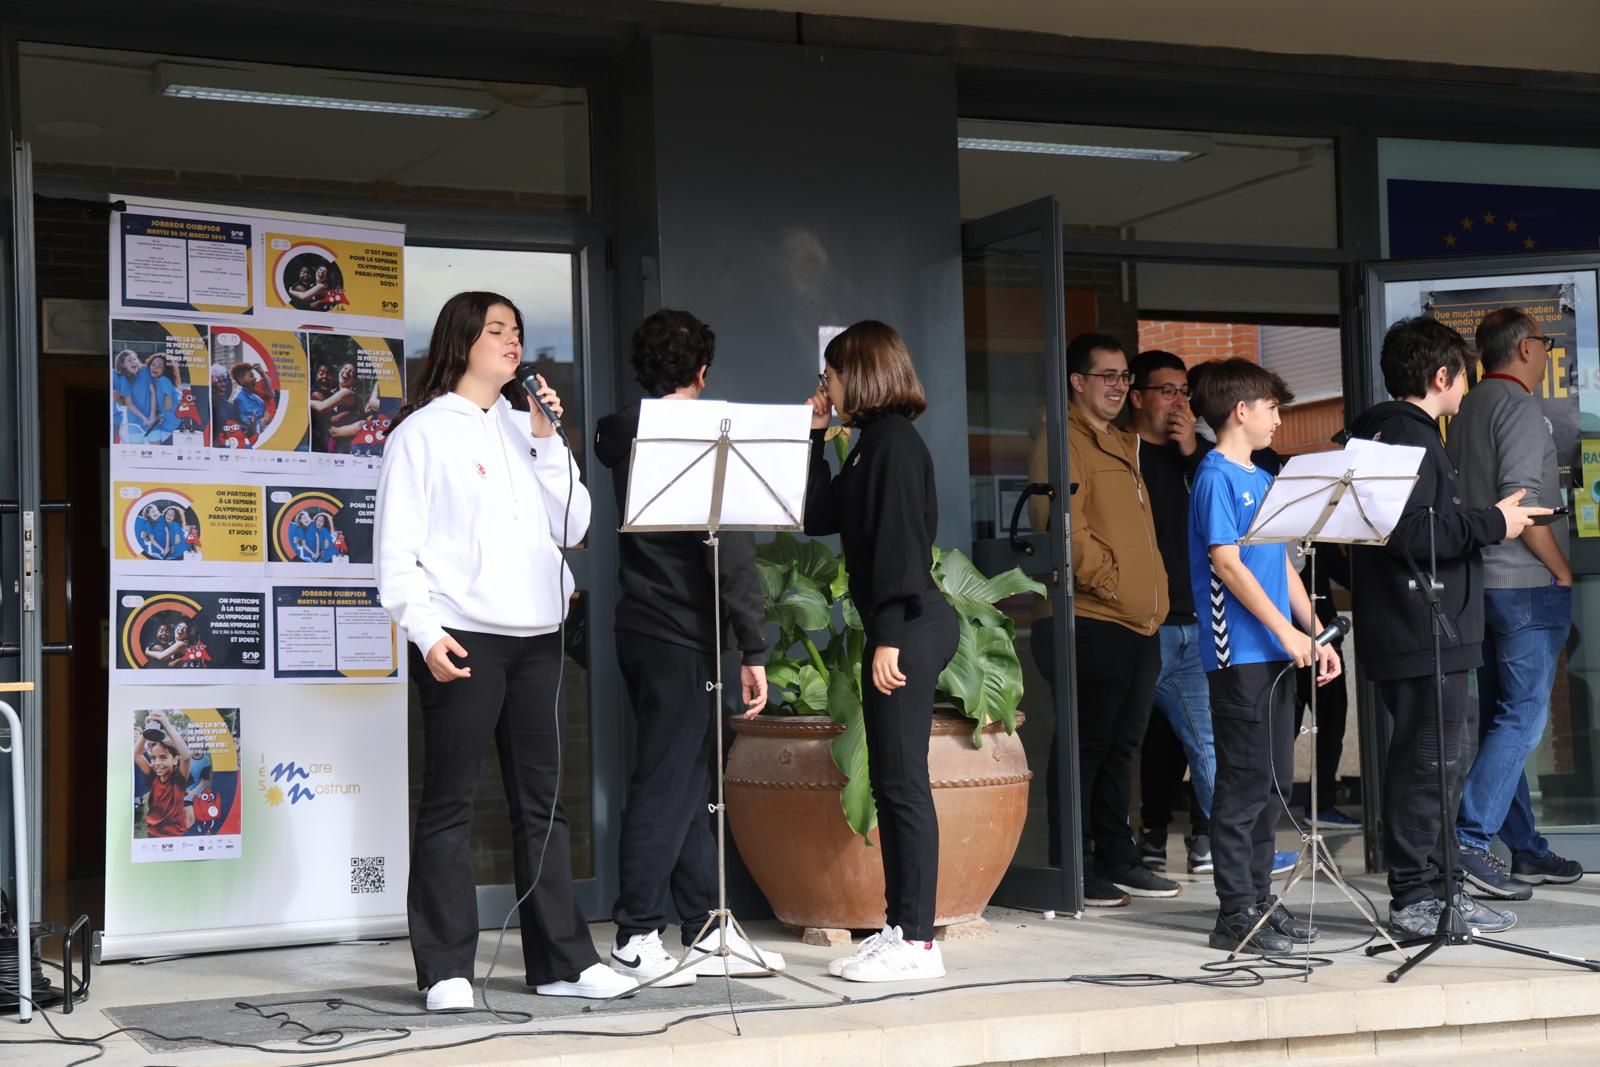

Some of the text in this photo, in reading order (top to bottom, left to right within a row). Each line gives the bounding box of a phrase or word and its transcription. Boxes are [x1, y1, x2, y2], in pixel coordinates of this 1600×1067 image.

[152, 220, 185, 229] JORNADA
[357, 263, 390, 271] OLYMPIQUE
[1435, 311, 1450, 320] Que
[1452, 309, 1485, 318] muchas
[1524, 305, 1554, 314] acaben
[1546, 314, 1562, 324] que
[1583, 452, 1600, 464] RA
